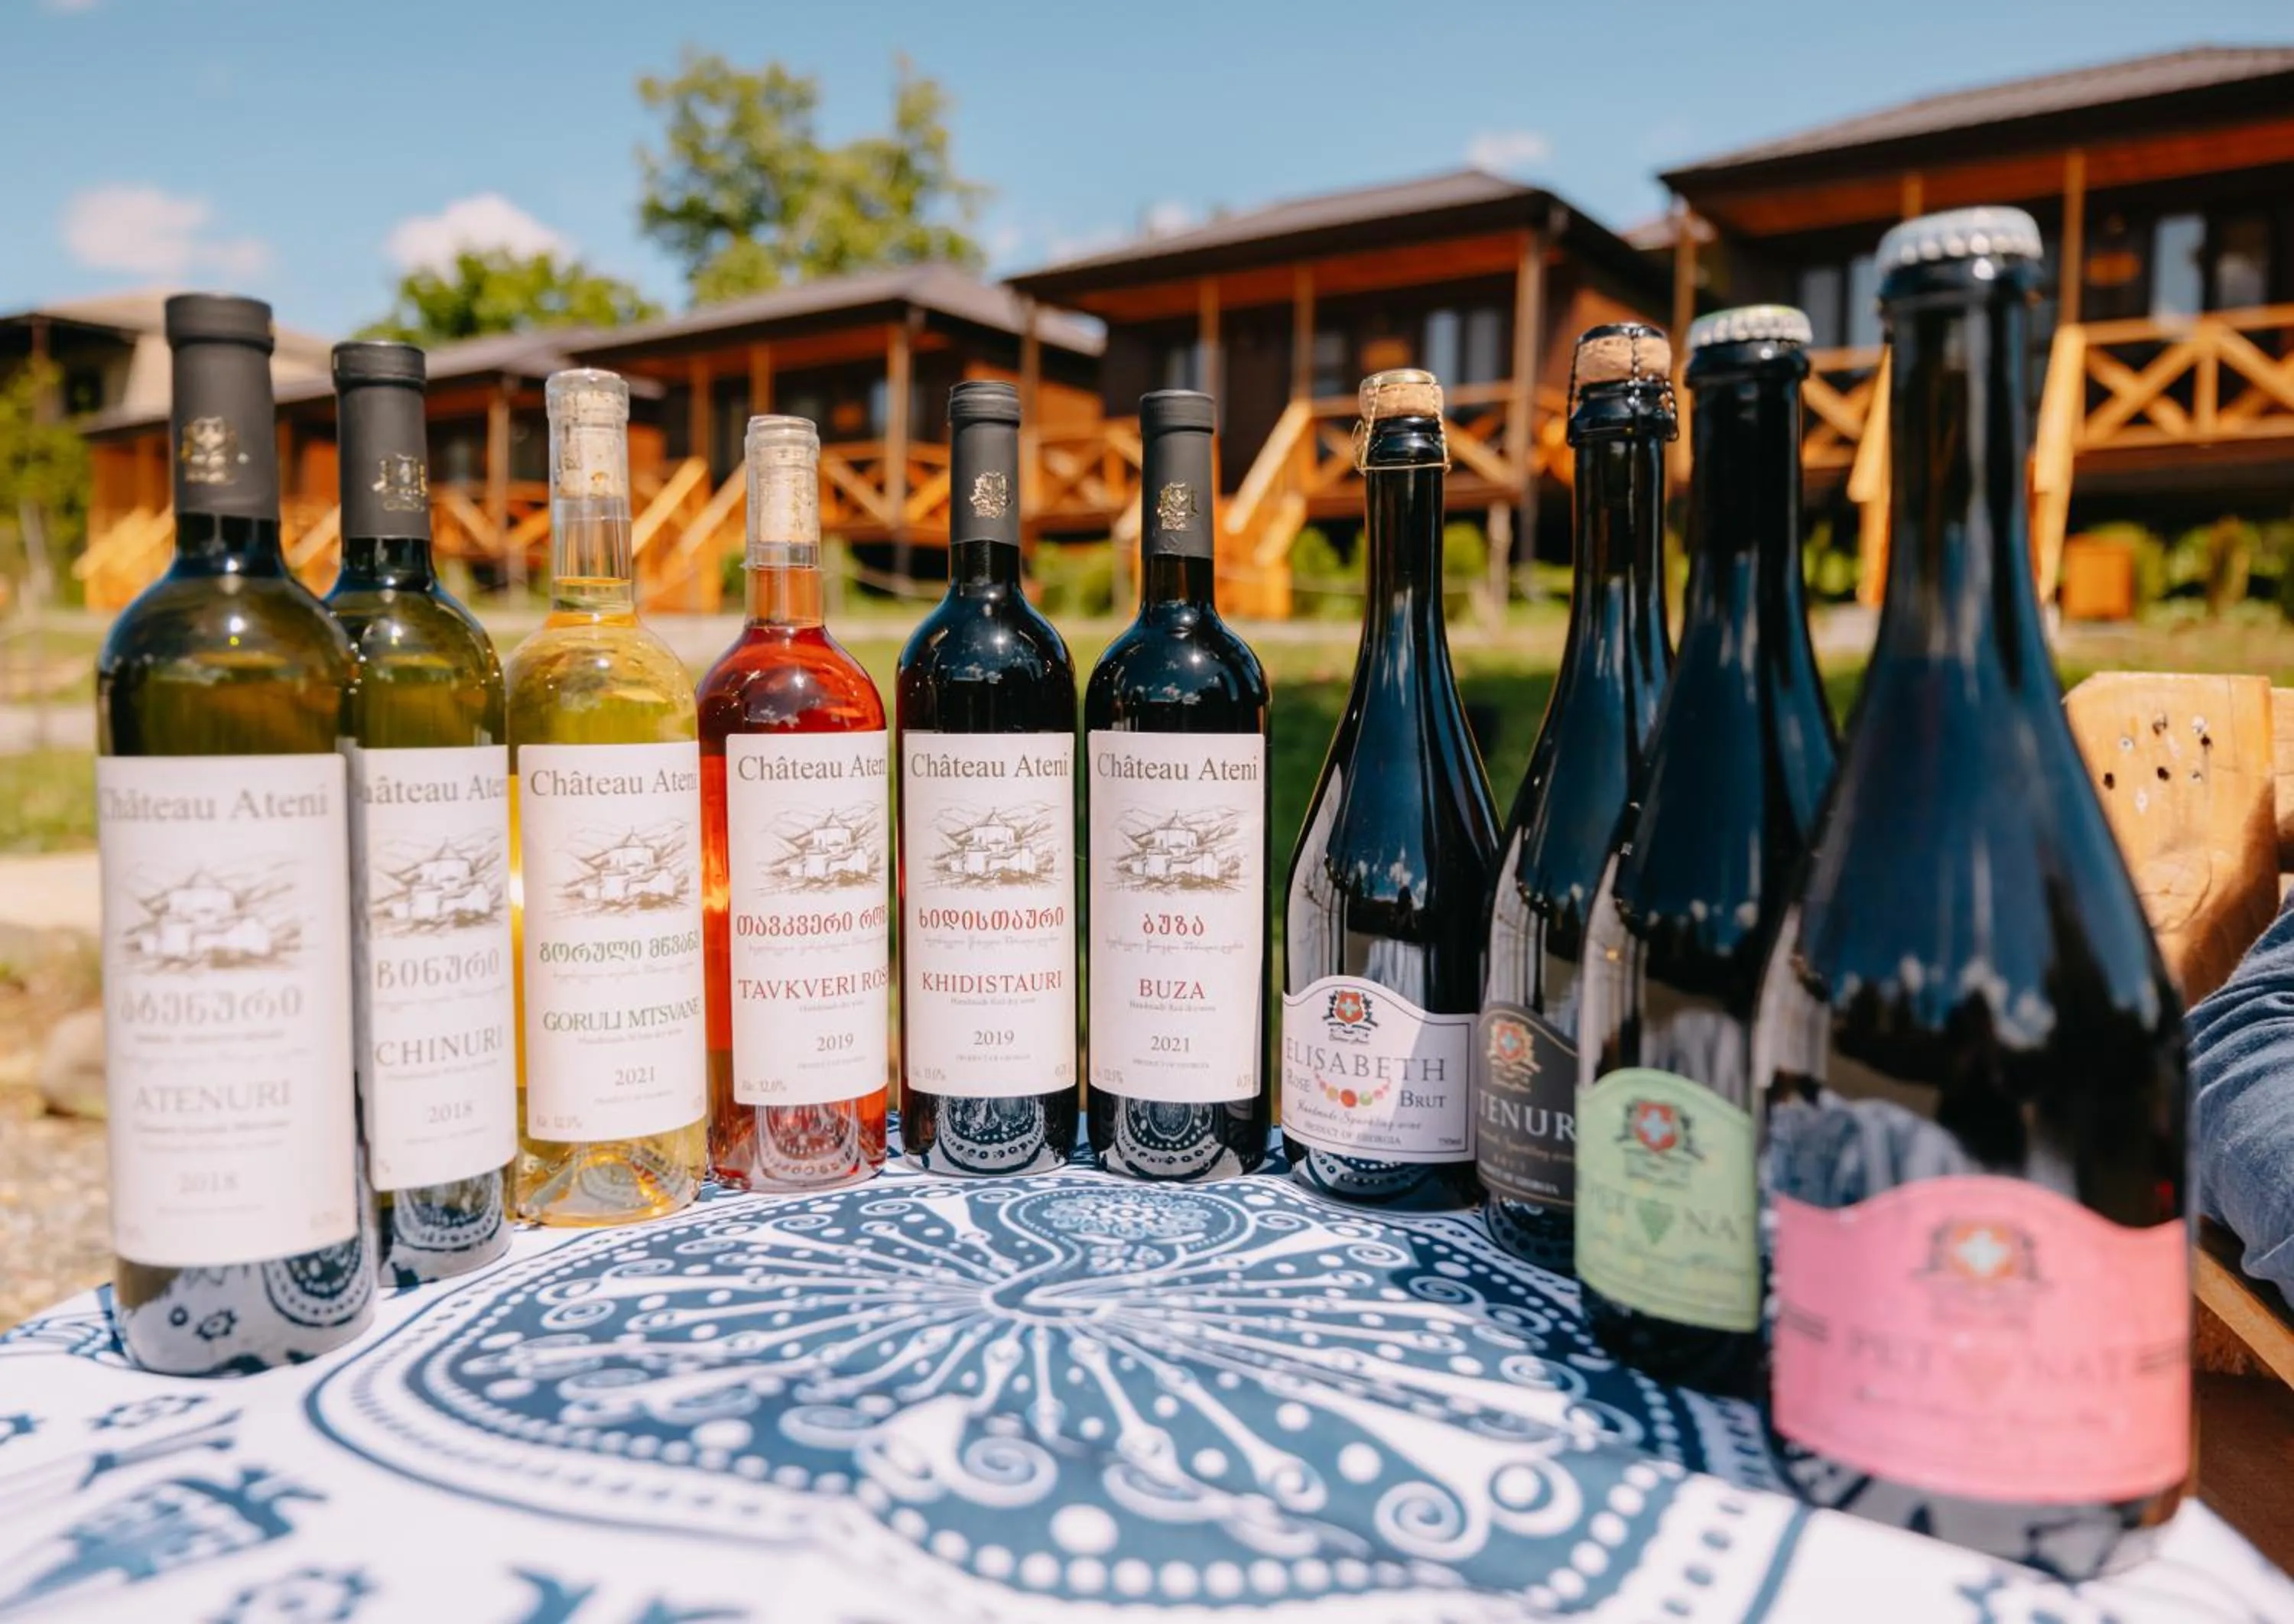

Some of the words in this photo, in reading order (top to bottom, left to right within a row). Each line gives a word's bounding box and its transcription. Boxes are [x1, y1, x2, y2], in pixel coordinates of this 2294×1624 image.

[738, 755, 842, 781] Château
[850, 753, 886, 778] Aten
[911, 752, 1005, 778] Château
[1015, 752, 1068, 778] Ateni
[1097, 752, 1189, 781] Château
[1198, 754, 1257, 781] Ateni
[355, 775, 457, 804] hâteau
[466, 774, 509, 801] Ate
[530, 768, 643, 797] Château
[230, 782, 329, 820] Ateni
[736, 911, 853, 937] თავკვერი
[919, 906, 1064, 931] ხიდისთაური
[1142, 913, 1204, 937] ბუზა
[538, 939, 642, 964] გორული
[738, 973, 856, 1000] TAVKVERI
[862, 963, 889, 992] ROS
[921, 970, 1062, 994] KHIDISTAURI
[1139, 978, 1206, 1000] BUZA
[543, 1009, 622, 1031] GORULI
[375, 1025, 504, 1067] CHINURI
[817, 1033, 854, 1051] 2019
[973, 1030, 1015, 1046] 2019
[1151, 1035, 1190, 1053] 2021
[1285, 1037, 1445, 1081] ELISABETH
[614, 1066, 656, 1086] 2021
[133, 1078, 291, 1113] ATENURI
[1479, 1089, 1577, 1142] TENUR
